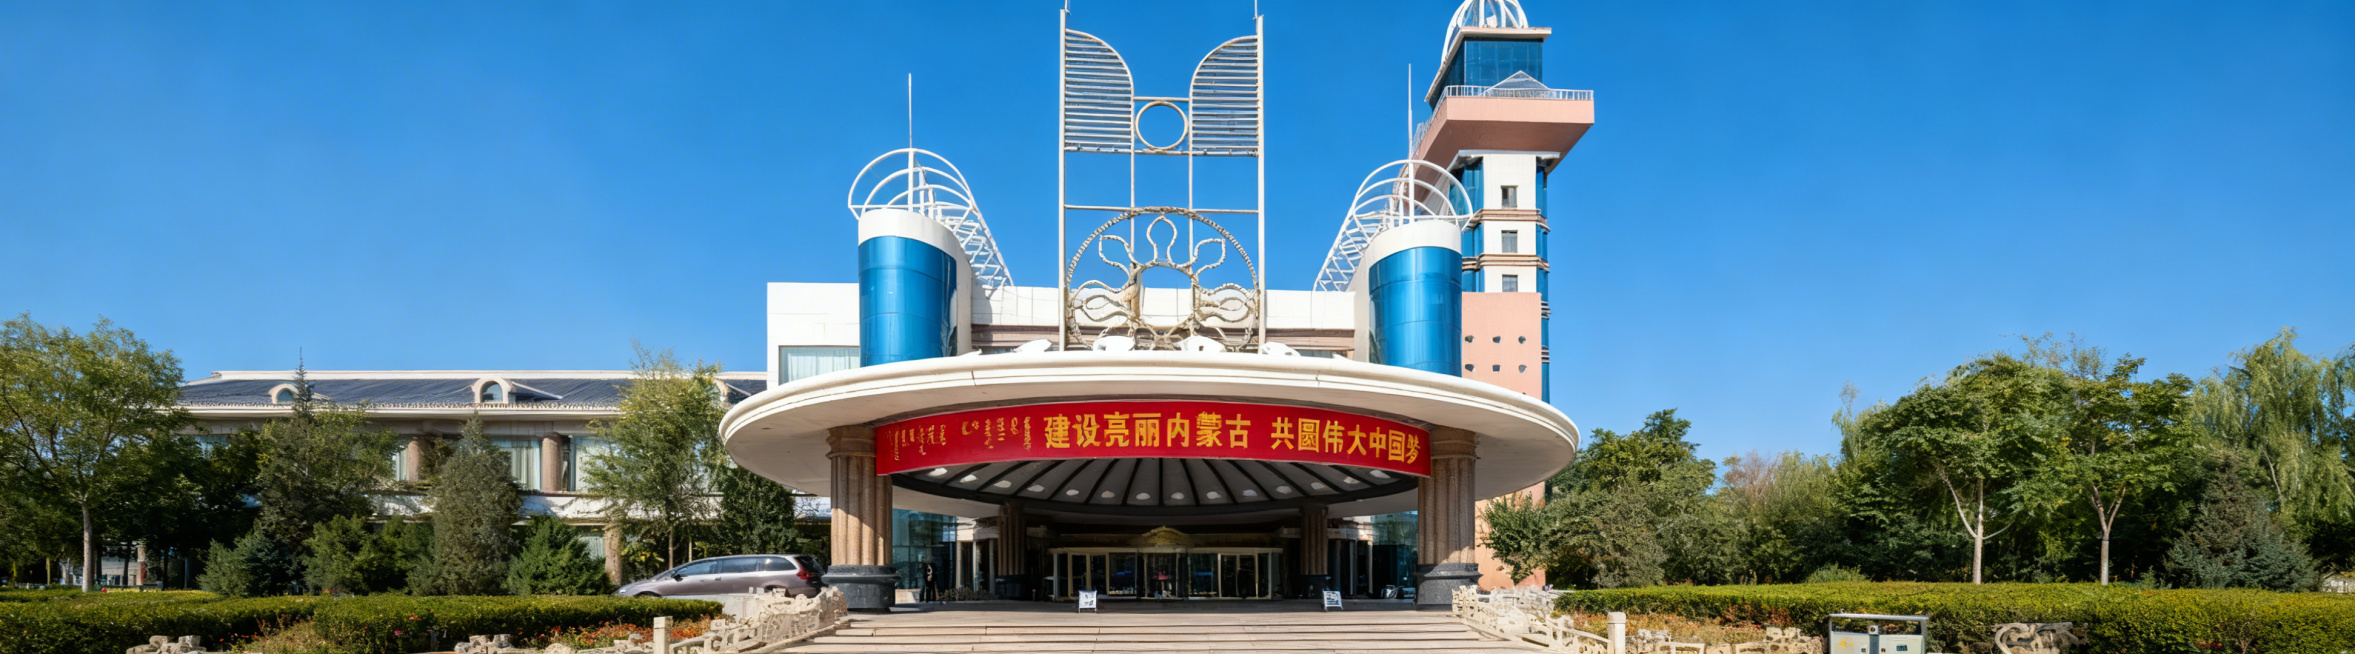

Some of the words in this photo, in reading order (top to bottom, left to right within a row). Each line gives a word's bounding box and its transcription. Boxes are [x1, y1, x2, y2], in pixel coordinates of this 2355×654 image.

[1043, 411, 1251, 449] 建设亮丽内蒙古
